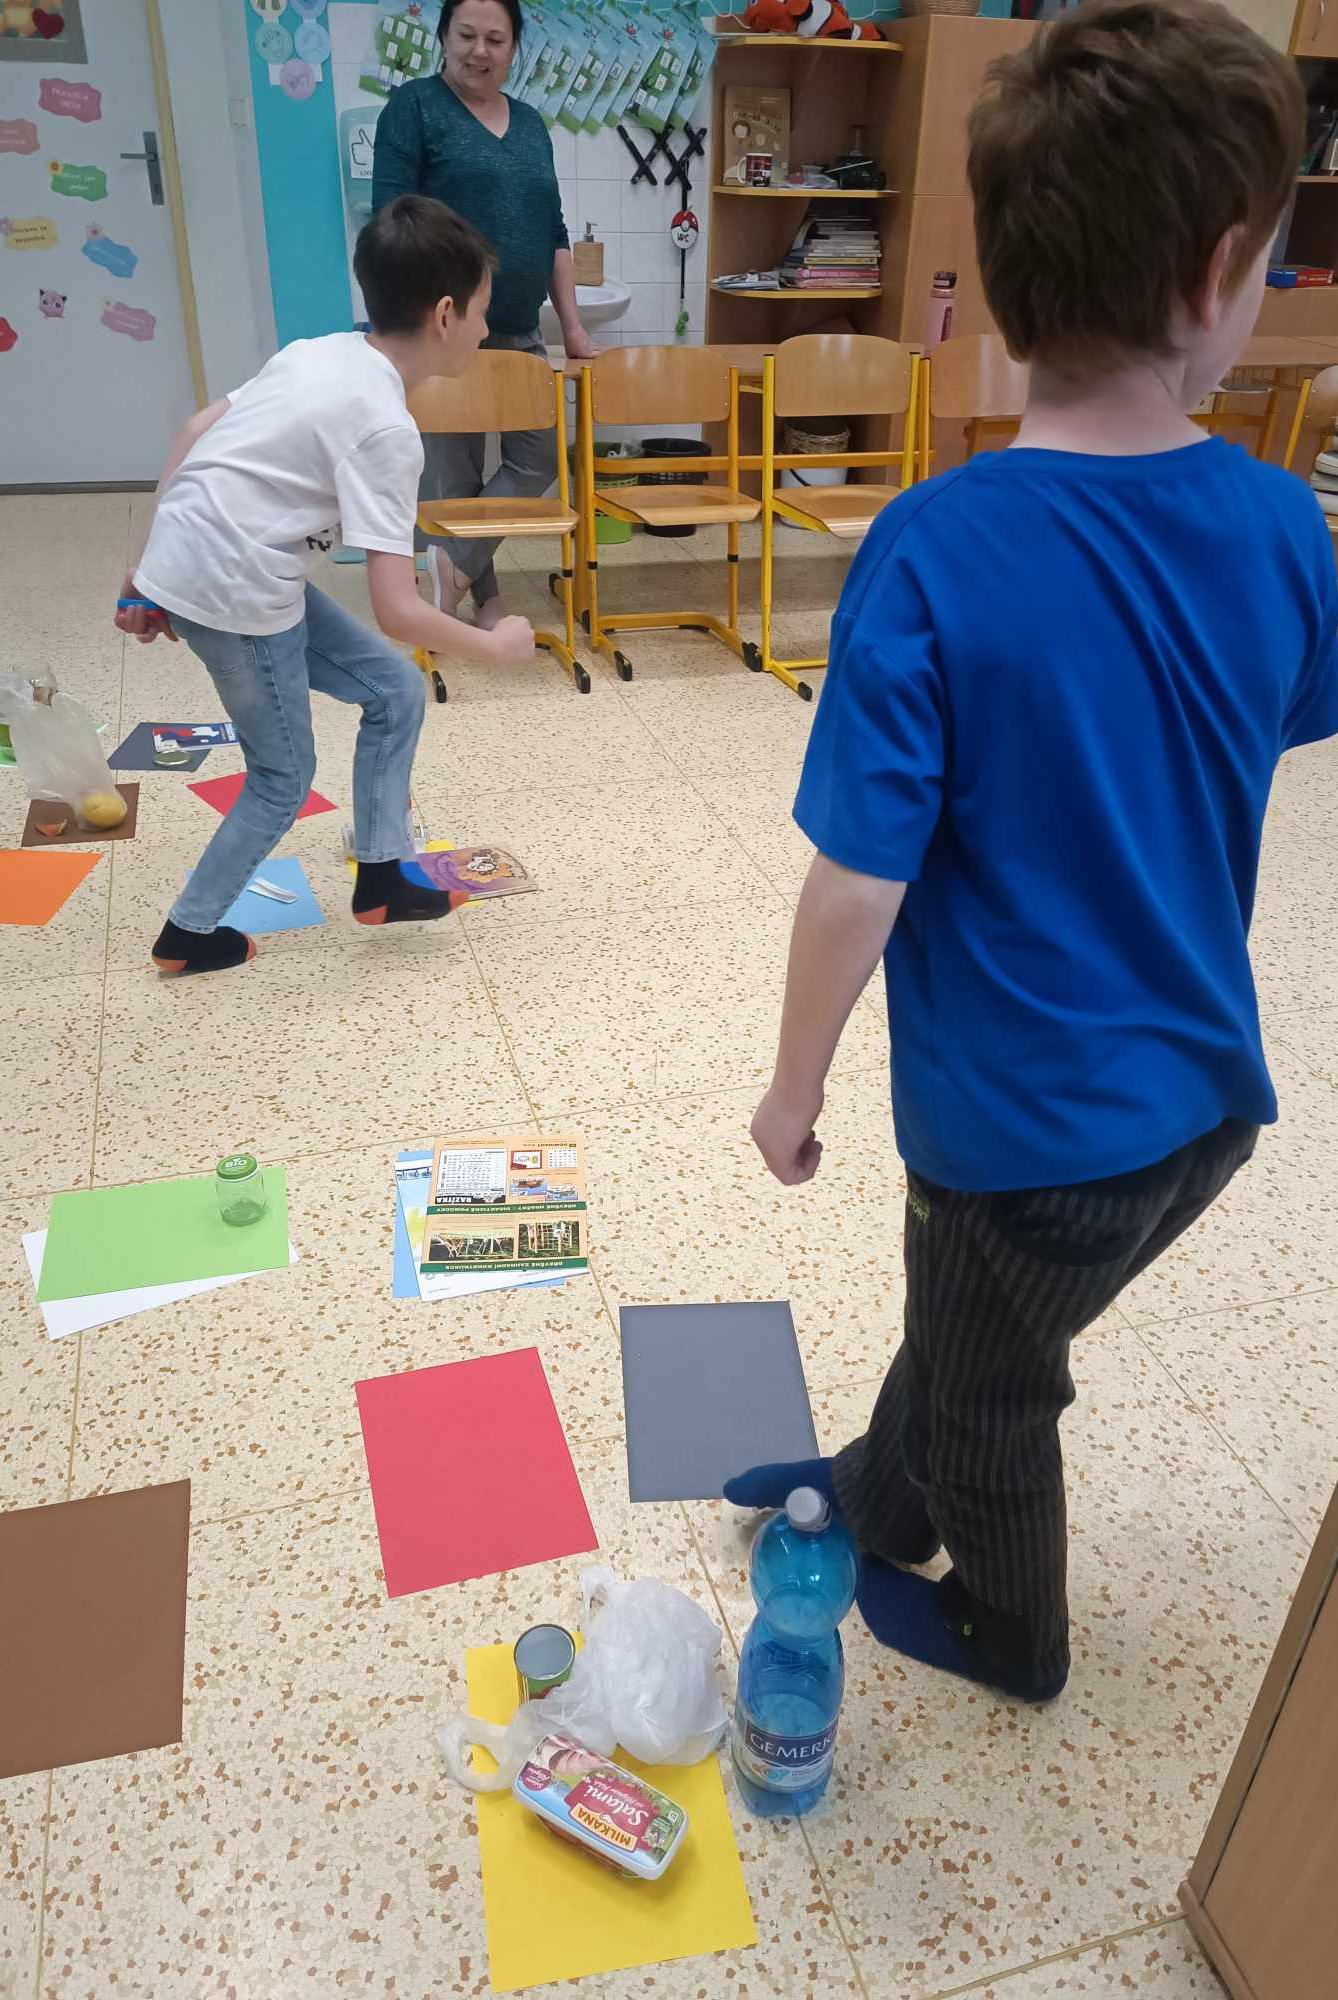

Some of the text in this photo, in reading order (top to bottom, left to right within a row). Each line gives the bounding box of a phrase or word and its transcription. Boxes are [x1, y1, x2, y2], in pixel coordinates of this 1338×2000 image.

[225, 1158, 247, 1167] BIO
[436, 1196, 472, 1204] RAZÍTKA
[583, 1785, 649, 1825] Salami
[577, 1807, 632, 1847] MILKANA
